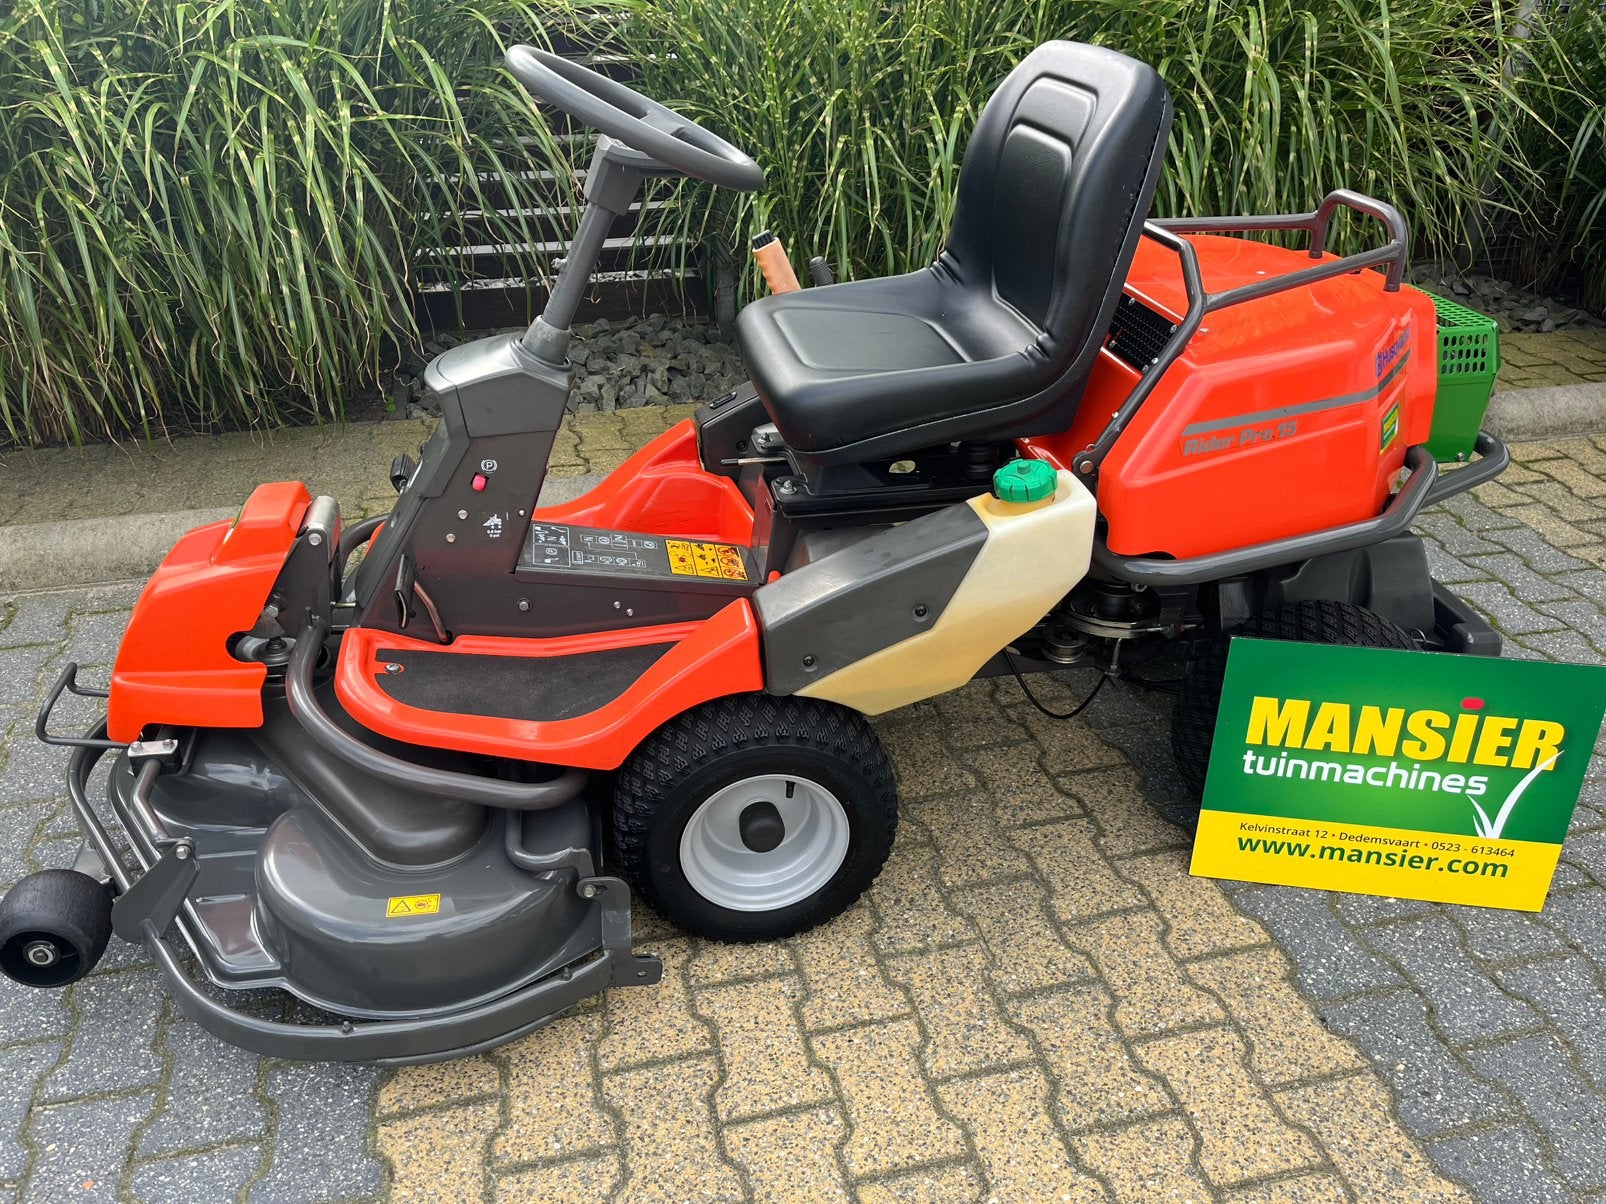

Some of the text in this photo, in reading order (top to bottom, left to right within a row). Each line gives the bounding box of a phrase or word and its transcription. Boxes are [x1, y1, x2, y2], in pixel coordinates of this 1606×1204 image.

[1184, 419, 1297, 456] Rider Pro 15
[1245, 696, 1565, 771] MANSIER
[1243, 750, 1488, 796] tuinmachines
[1238, 837, 1508, 878] www.mansier.com
[1240, 822, 1310, 837] Kelvinstraat
[1314, 829, 1328, 839] 12
[1339, 832, 1420, 848] Dedemsvaart
[1431, 841, 1461, 852] 0523
[1471, 846, 1515, 857] 613464
